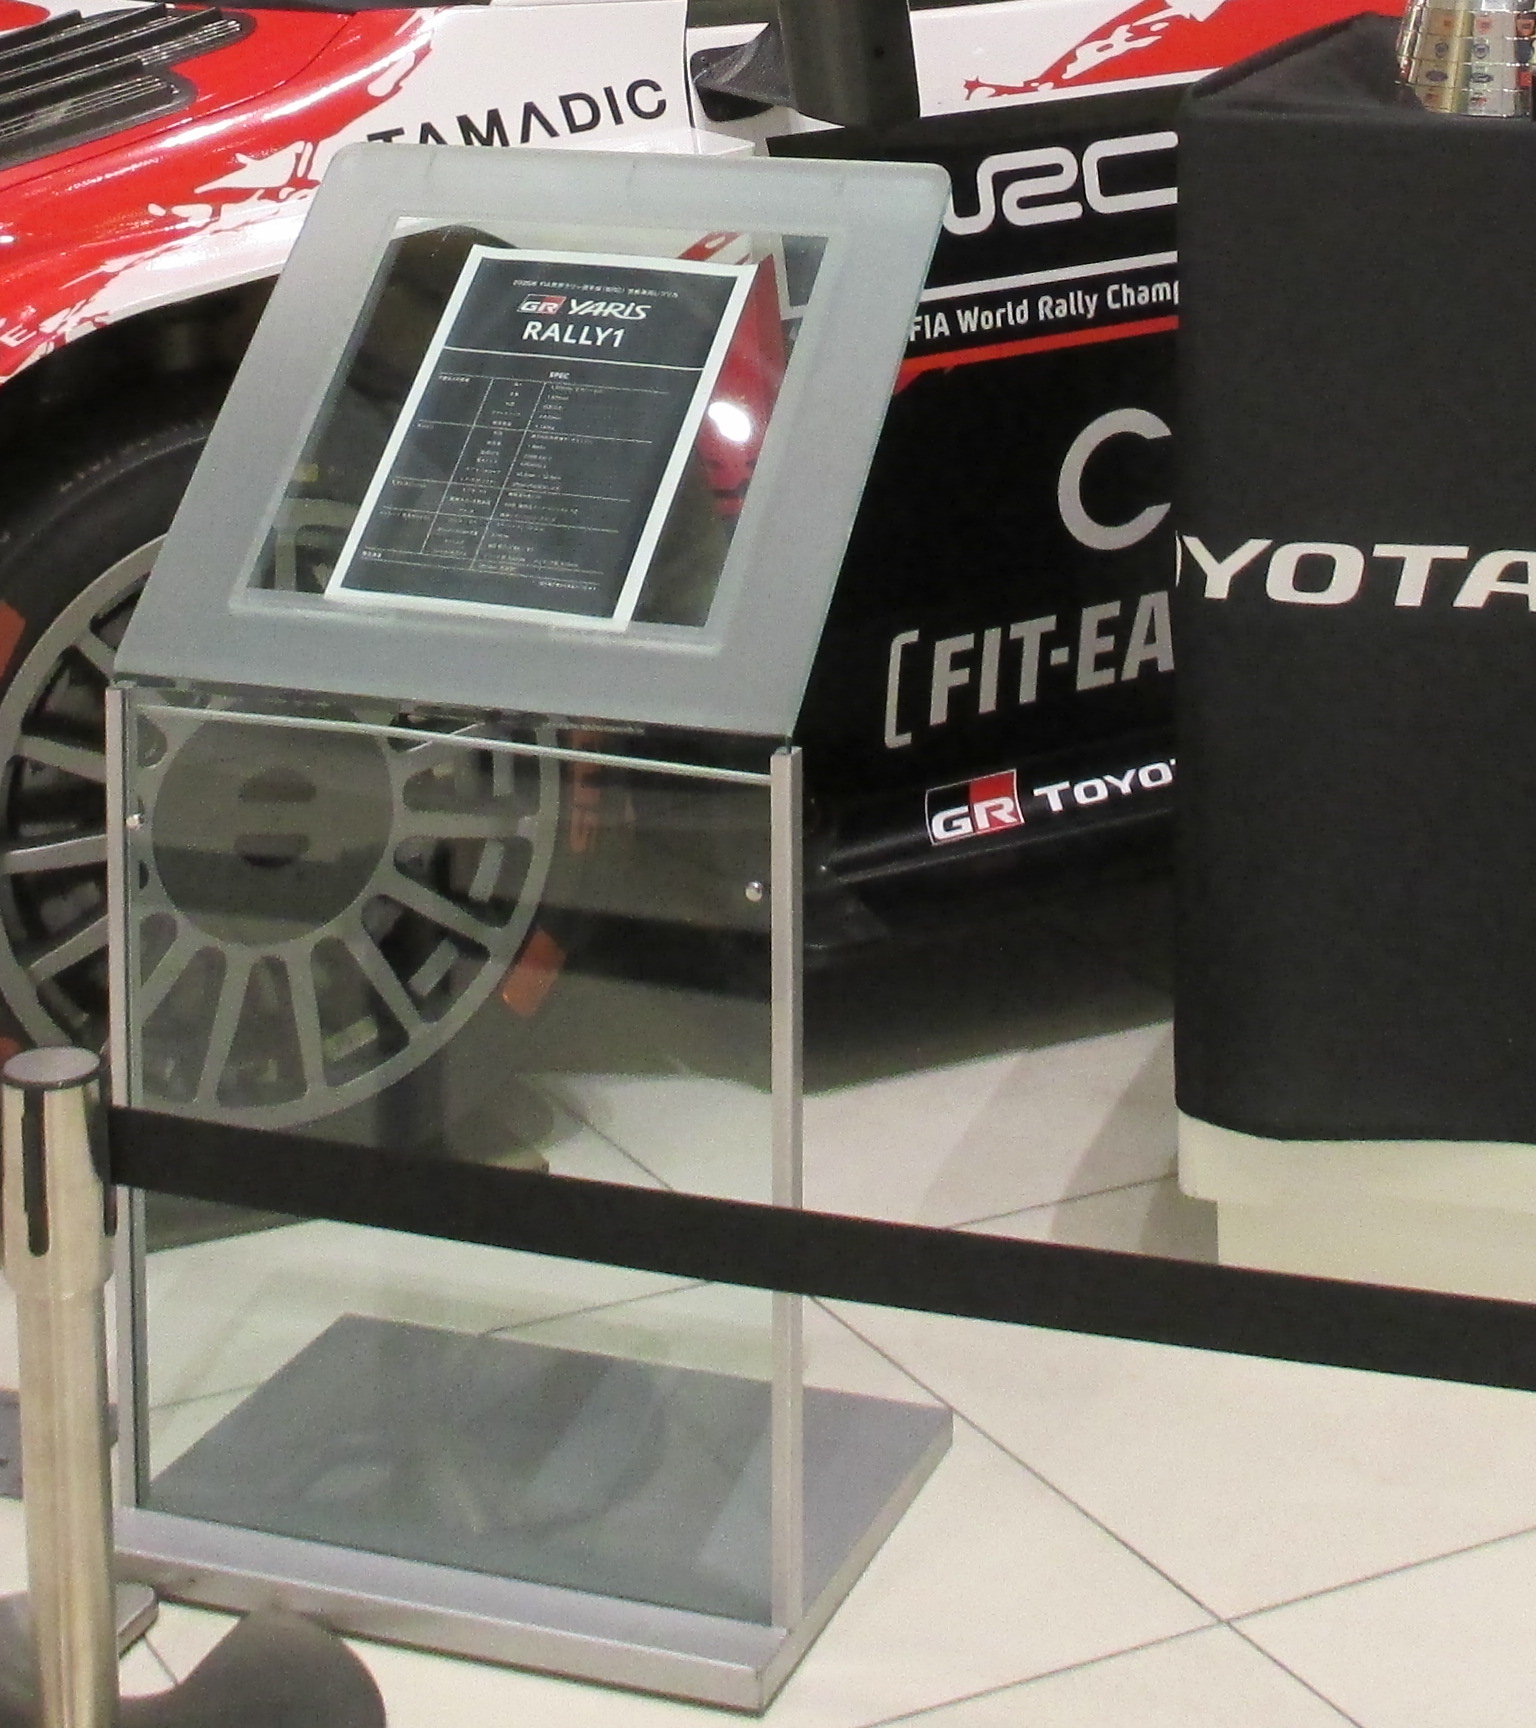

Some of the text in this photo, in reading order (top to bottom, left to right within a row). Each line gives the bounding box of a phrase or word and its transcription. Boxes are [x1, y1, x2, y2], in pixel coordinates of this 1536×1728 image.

[521, 320, 626, 349] RALLY1
[909, 311, 950, 342] FIA
[956, 299, 1029, 334] World
[1037, 290, 1099, 320] Rally
[883, 590, 1176, 750] [FIT-EA
[1033, 758, 1176, 813] TOYO
